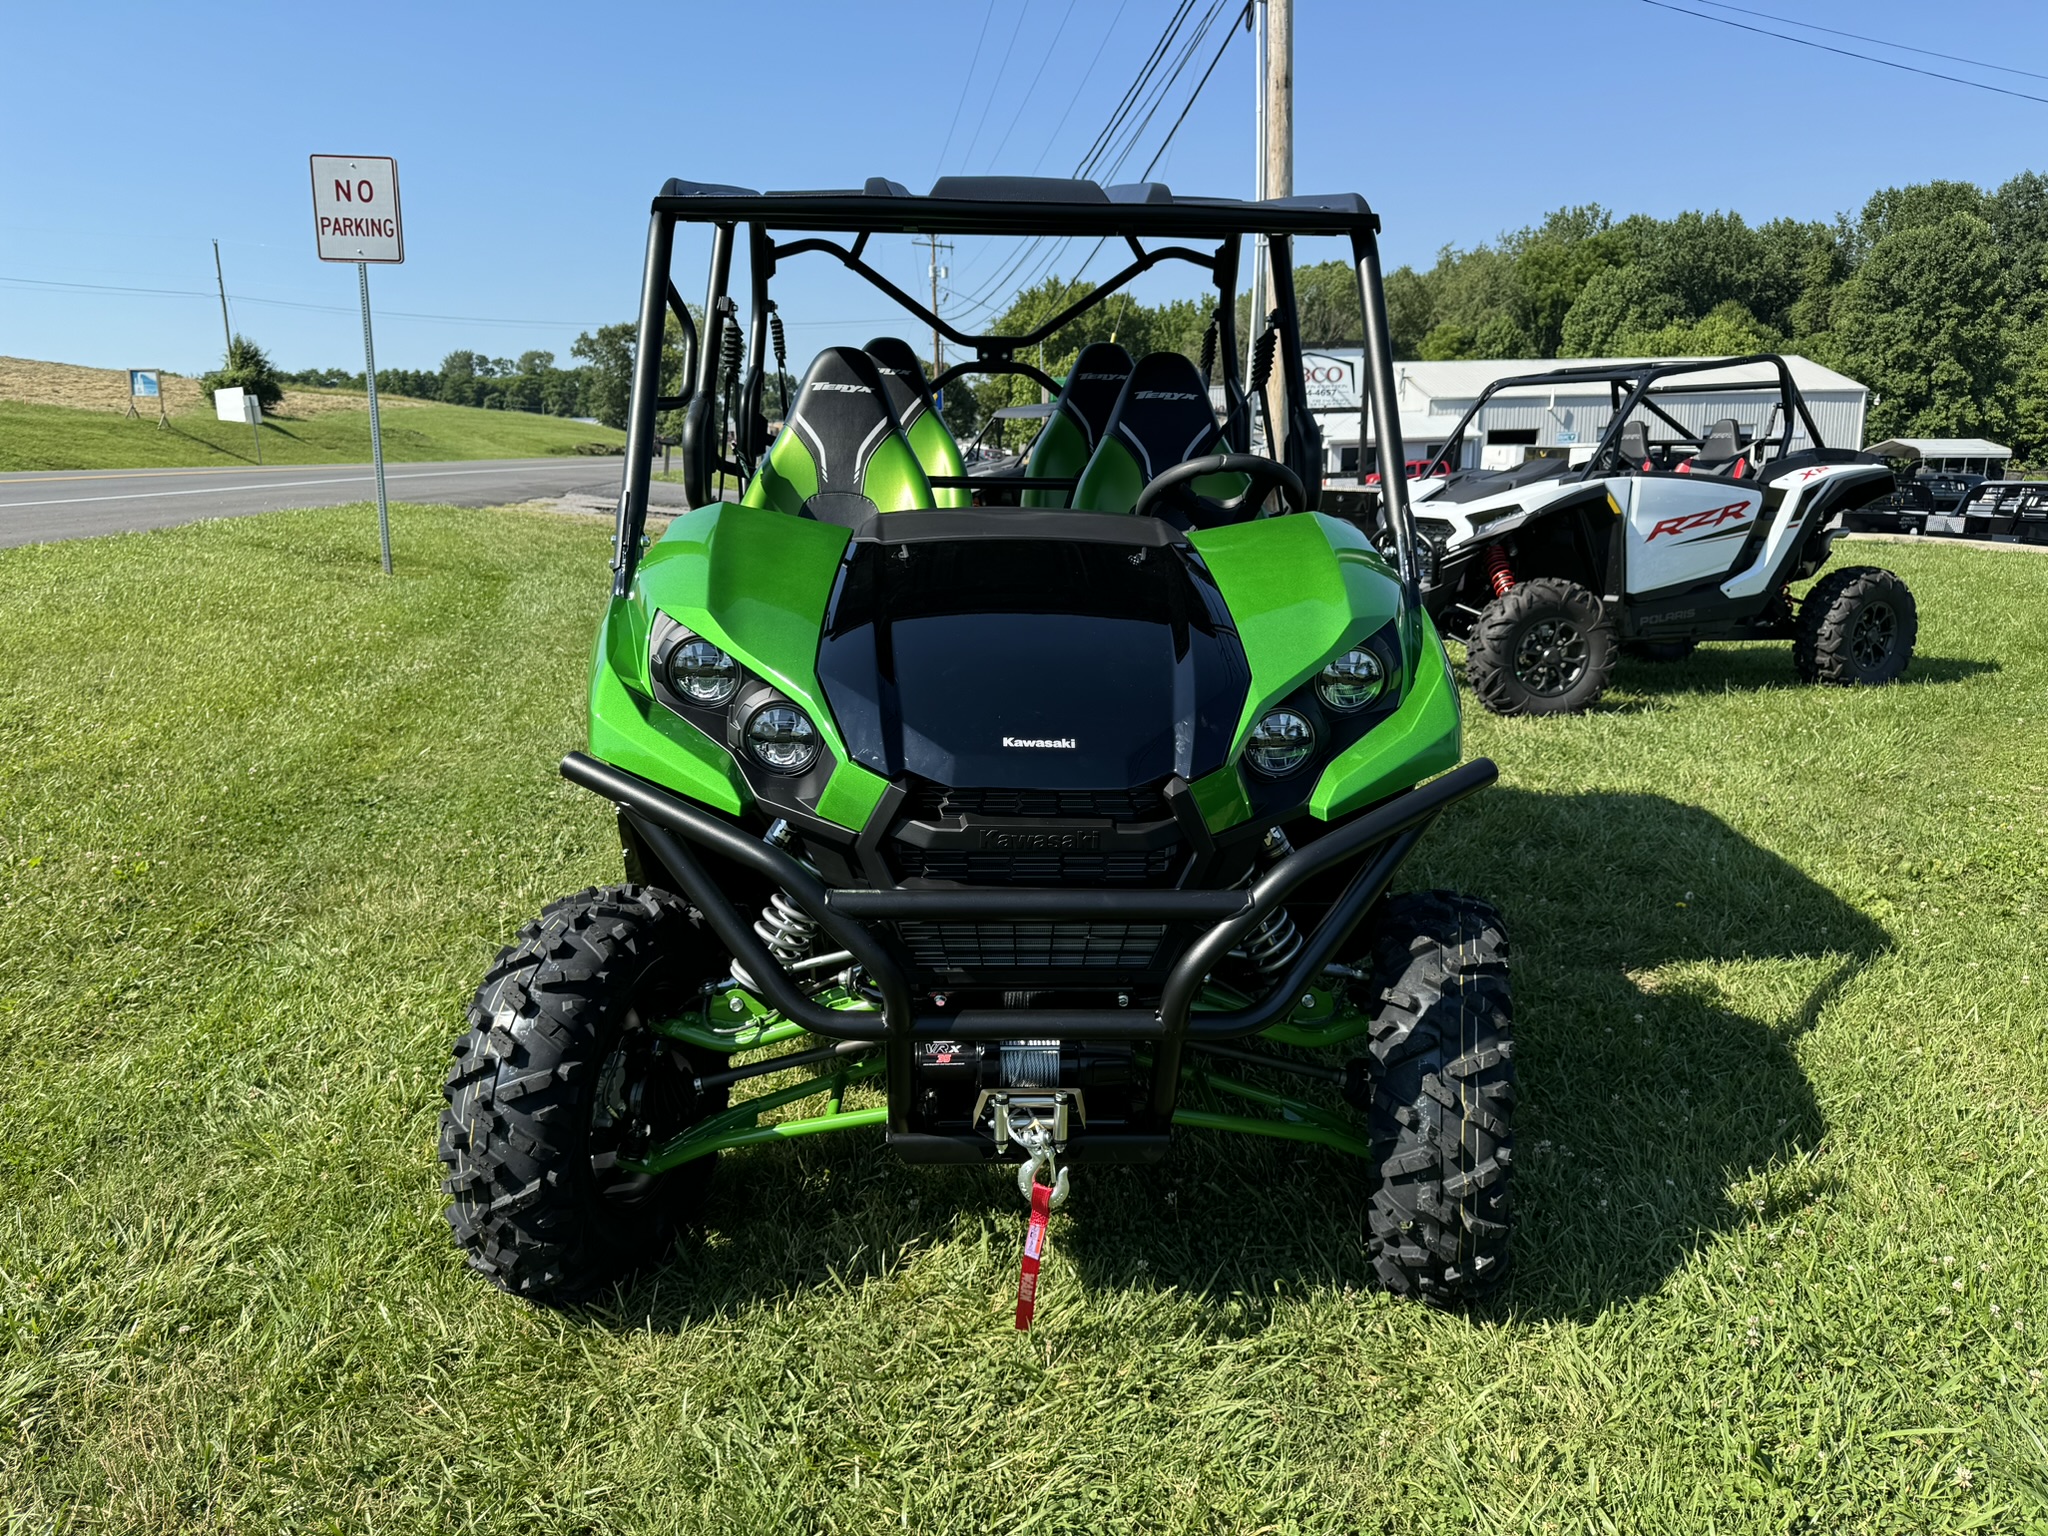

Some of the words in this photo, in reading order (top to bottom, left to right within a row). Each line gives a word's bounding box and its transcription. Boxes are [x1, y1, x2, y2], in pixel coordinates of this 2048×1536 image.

[334, 179, 374, 203] NO
[320, 216, 395, 238] PARKING
[1644, 500, 1751, 544] RZR
[1639, 608, 1696, 627] POLARIS
[1002, 737, 1076, 749] Kawasaki
[979, 829, 1099, 850] Kawasaki
